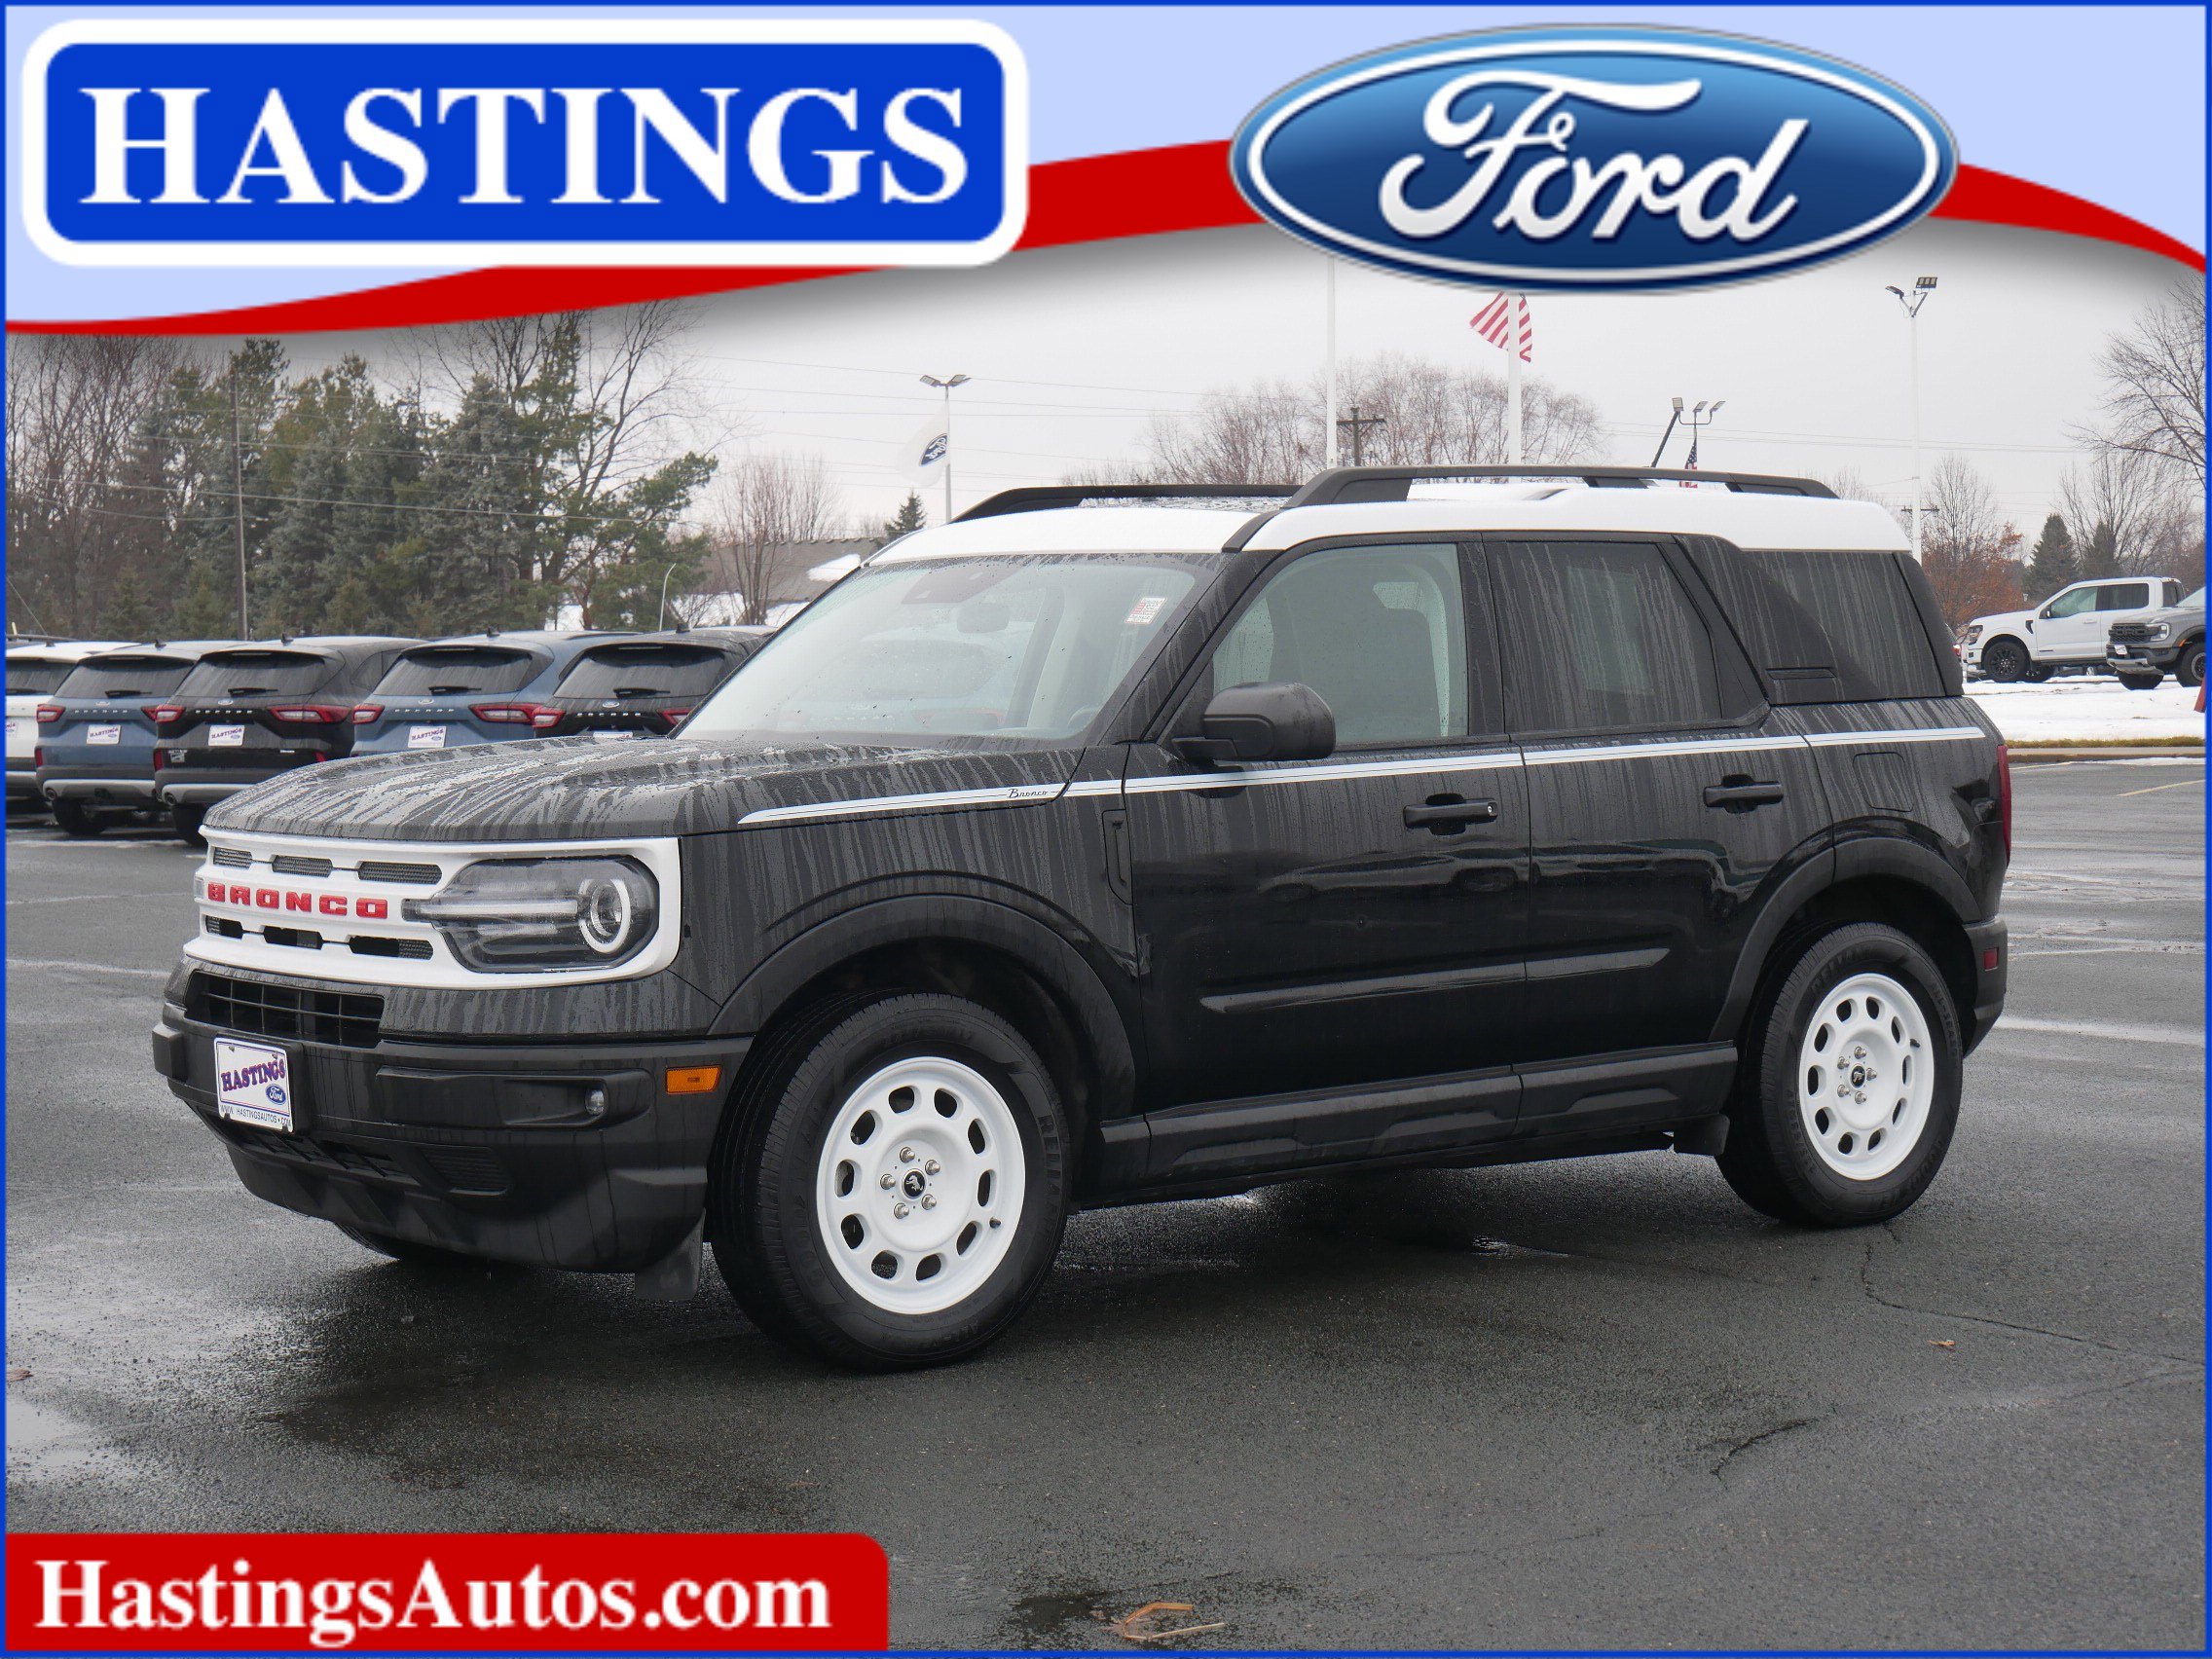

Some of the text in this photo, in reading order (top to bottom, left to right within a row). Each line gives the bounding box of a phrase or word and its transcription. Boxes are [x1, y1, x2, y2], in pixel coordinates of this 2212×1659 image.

[411, 728, 444, 741] HASTINGS
[1007, 788, 1049, 798] Bronco
[207, 881, 388, 919] BRONCO
[220, 1058, 286, 1092] HASTINGS
[269, 1086, 283, 1101] Ford
